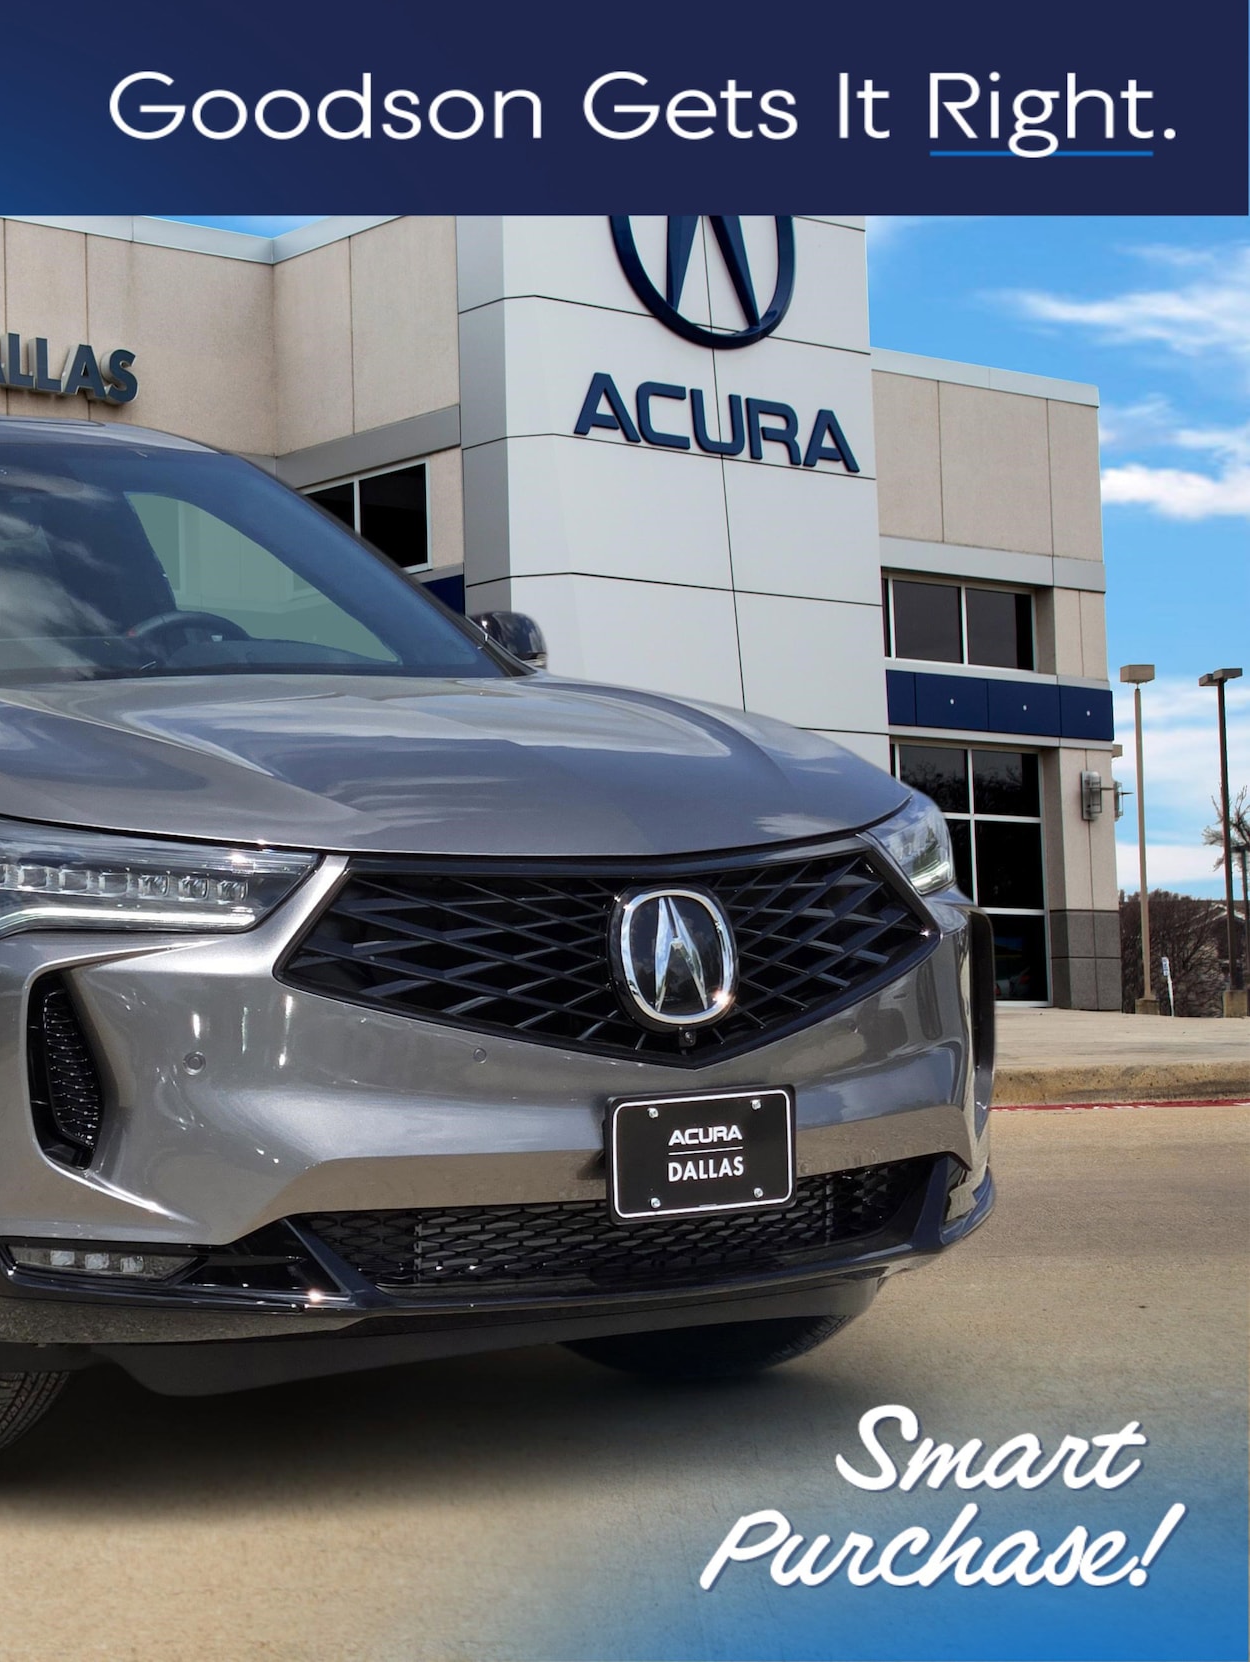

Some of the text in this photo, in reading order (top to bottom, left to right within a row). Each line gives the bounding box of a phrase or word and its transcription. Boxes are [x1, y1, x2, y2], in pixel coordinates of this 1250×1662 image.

[573, 371, 861, 474] ACURA
[667, 1124, 743, 1147] ACURA
[667, 1156, 745, 1183] DALLAS
